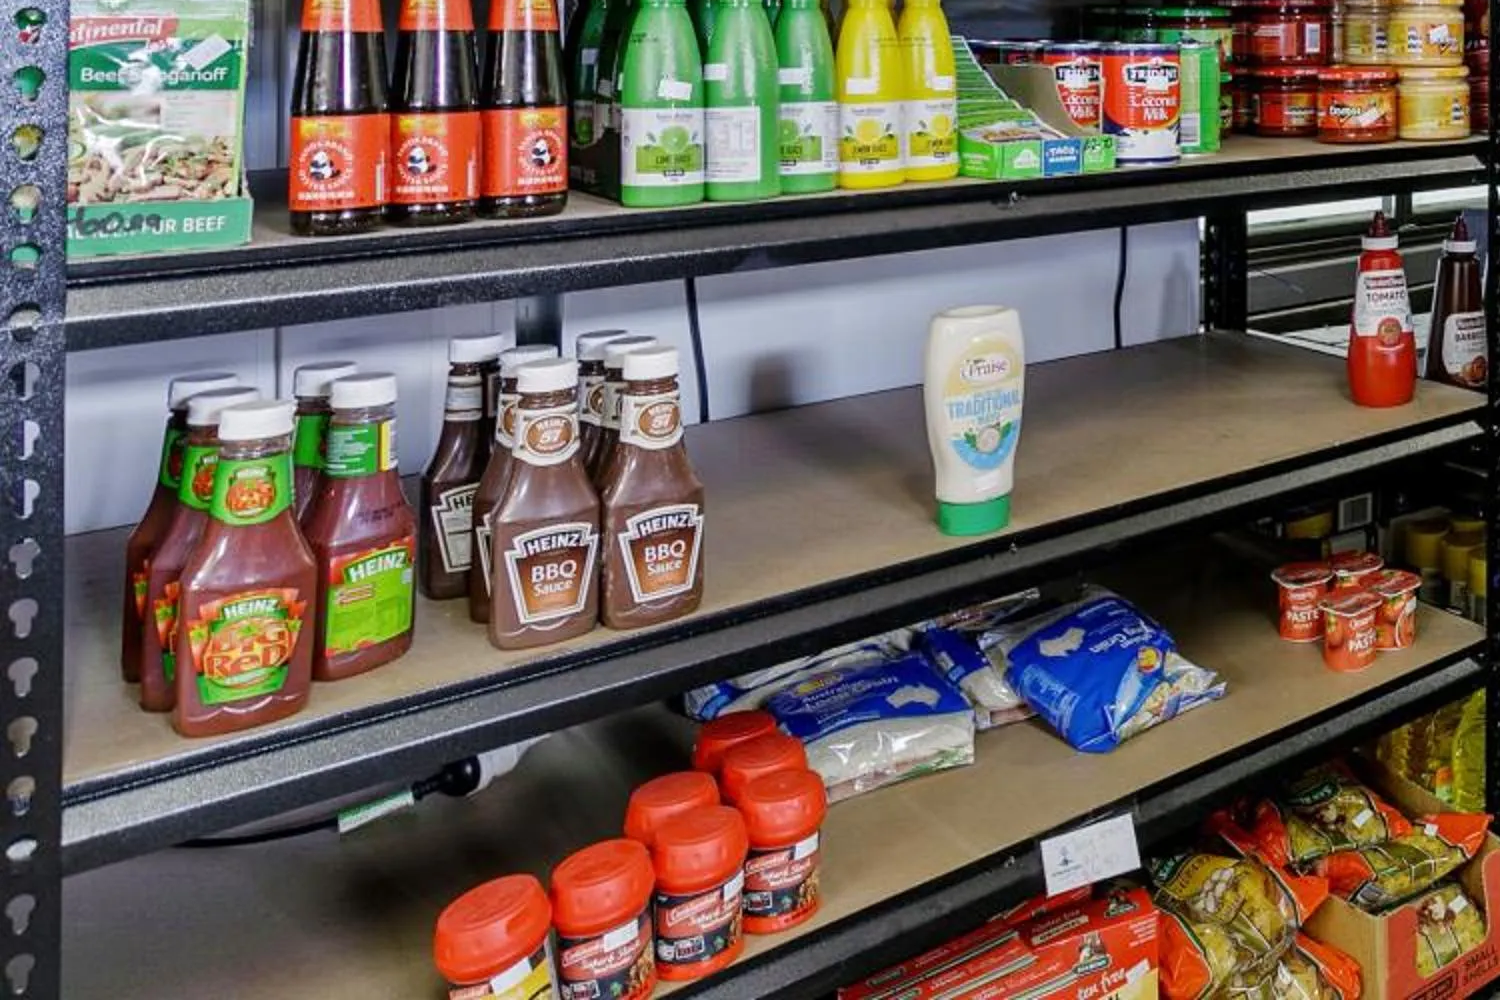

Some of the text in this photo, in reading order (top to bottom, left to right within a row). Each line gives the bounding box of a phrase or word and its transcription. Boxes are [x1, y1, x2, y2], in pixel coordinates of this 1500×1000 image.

[70, 18, 164, 43] tinental
[126, 66, 229, 85] Soganoff
[182, 215, 227, 233] BEEF
[638, 514, 690, 536] HEINZ
[527, 532, 583, 556] HEINZ
[645, 539, 687, 563] BBQ
[348, 551, 407, 582] HEINZ
[531, 559, 577, 583] BBQ
[647, 559, 682, 577] Sauce
[535, 579, 574, 597] Sauce
[223, 599, 278, 619] HEINZ
